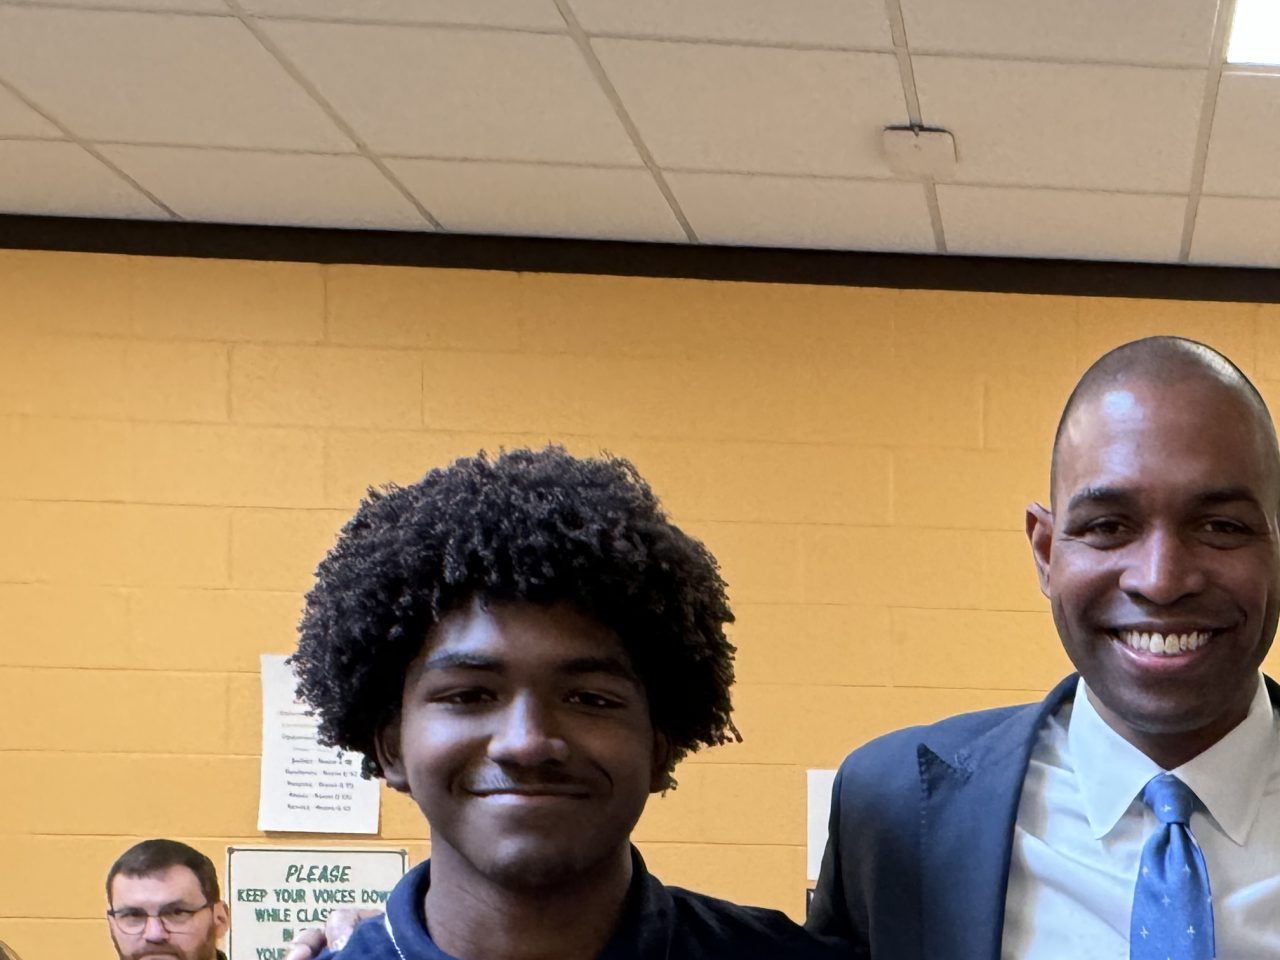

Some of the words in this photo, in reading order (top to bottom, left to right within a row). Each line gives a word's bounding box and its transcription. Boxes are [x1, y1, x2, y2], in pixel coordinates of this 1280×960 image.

[285, 864, 352, 883] PLEASE
[237, 888, 268, 903] KEEP
[274, 888, 306, 903] YOUR
[313, 888, 356, 904] VOICES
[254, 907, 291, 922] WHILE
[296, 907, 336, 922] CLAS
